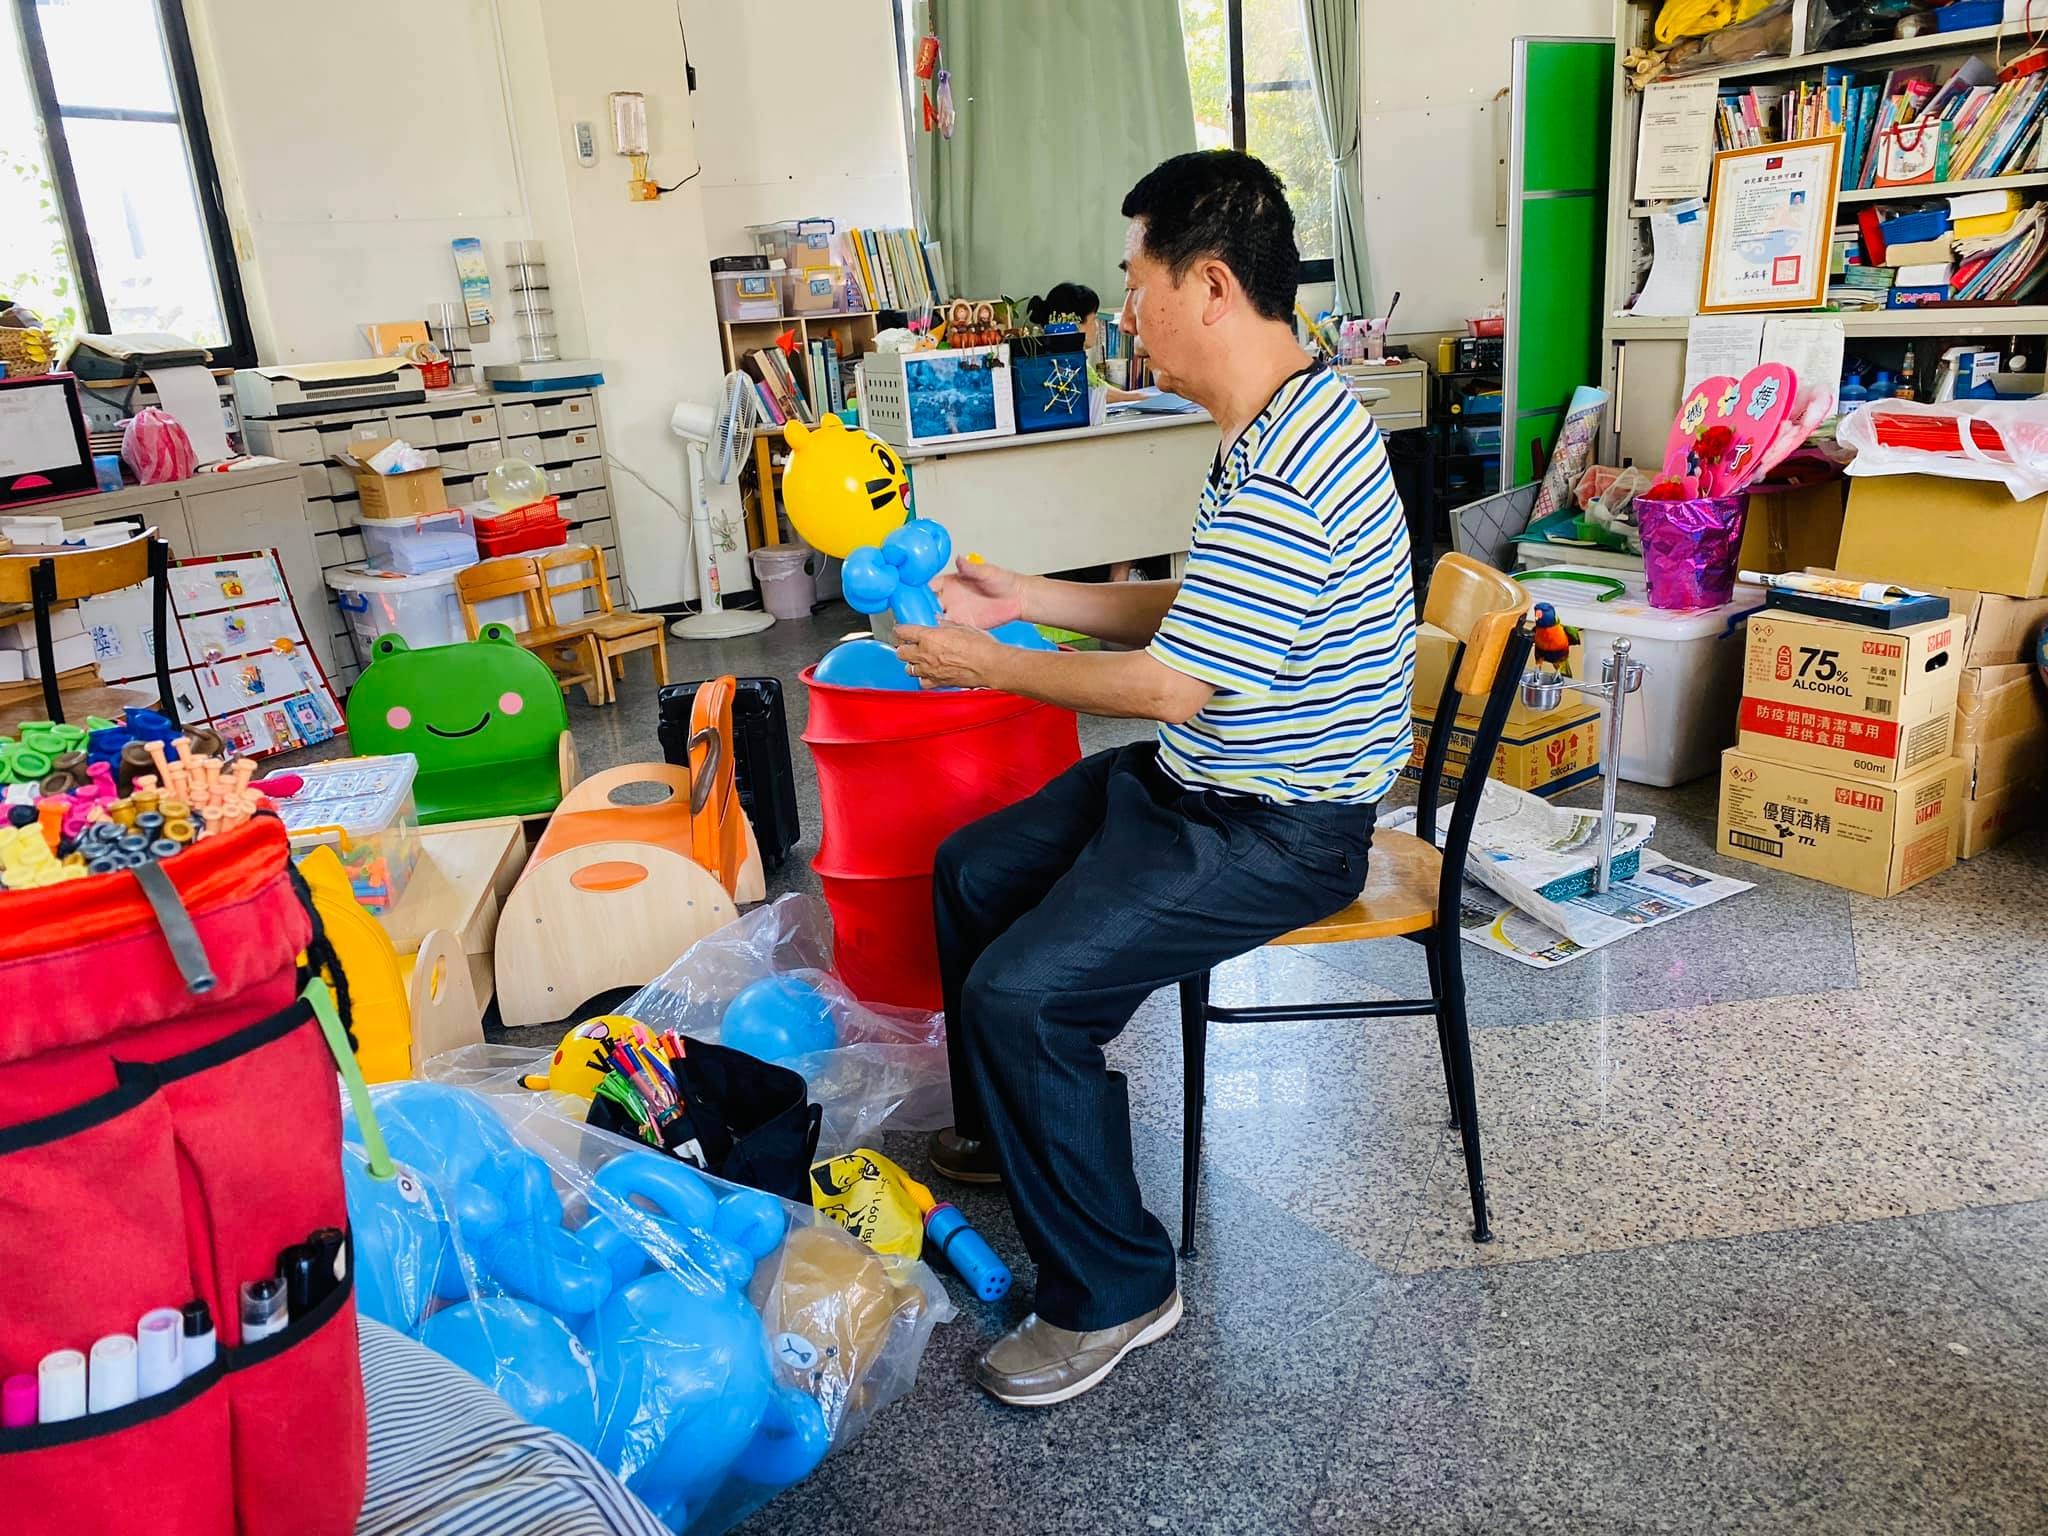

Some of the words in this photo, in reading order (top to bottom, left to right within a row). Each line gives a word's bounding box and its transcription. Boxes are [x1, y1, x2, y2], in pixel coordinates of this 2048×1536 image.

[1792, 678, 1853, 697] ALCOHOL
[1756, 704, 1880, 740] 防疫期間清潔專用
[1785, 725, 1846, 748] 非供食用
[1853, 759, 1886, 773] 600ml
[1762, 801, 1832, 834] 優質酒精
[1797, 834, 1817, 847] TTL
